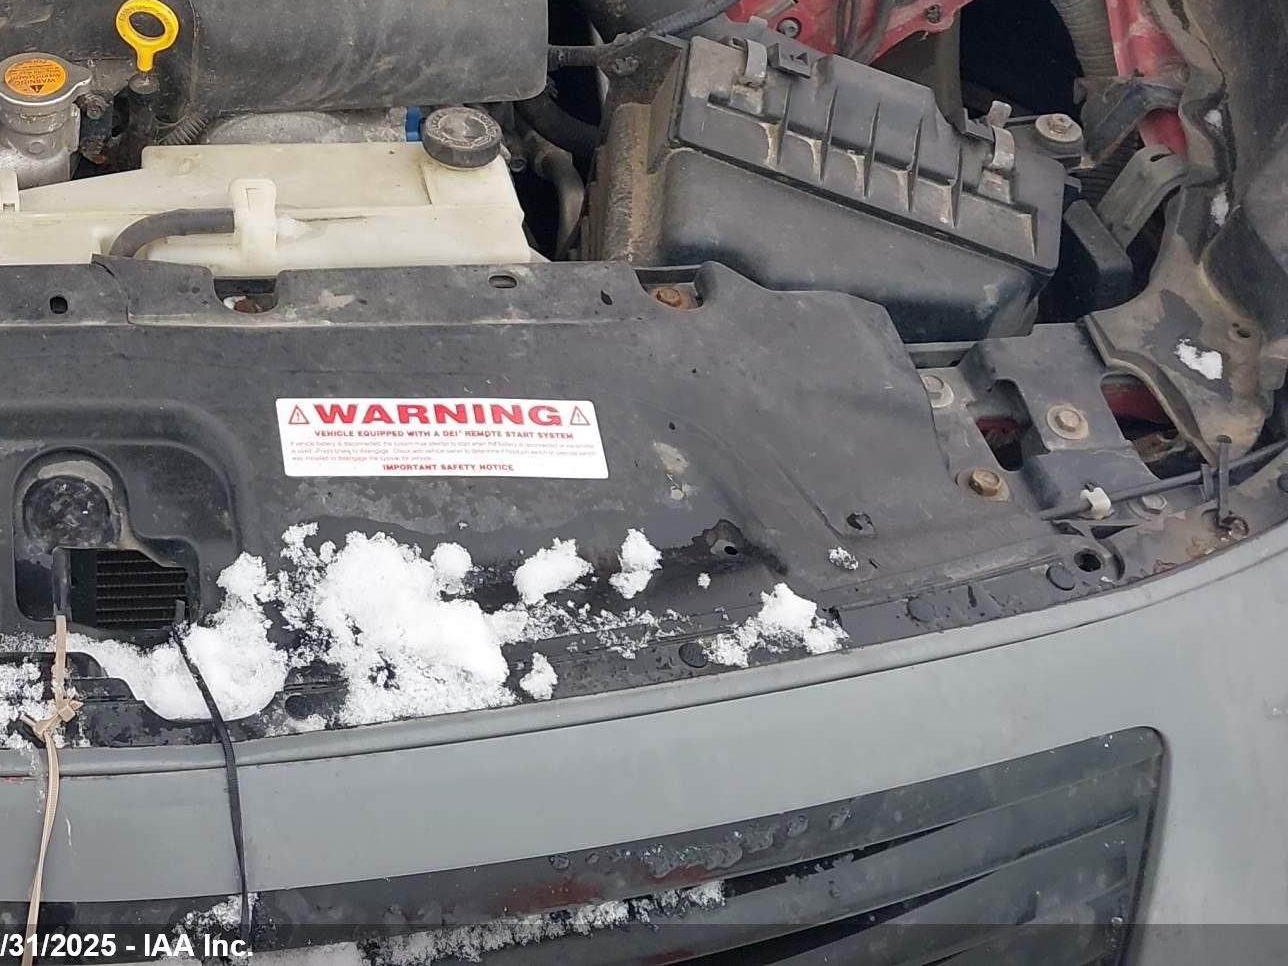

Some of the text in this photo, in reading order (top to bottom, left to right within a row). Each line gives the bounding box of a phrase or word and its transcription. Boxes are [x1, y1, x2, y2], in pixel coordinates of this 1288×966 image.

[314, 403, 562, 426] WARNING
[358, 430, 404, 438] EQUIPPED
[465, 430, 503, 438] REMOTE
[506, 431, 534, 439] START
[537, 432, 574, 440] SYSTEM
[479, 464, 515, 472] NOTICE
